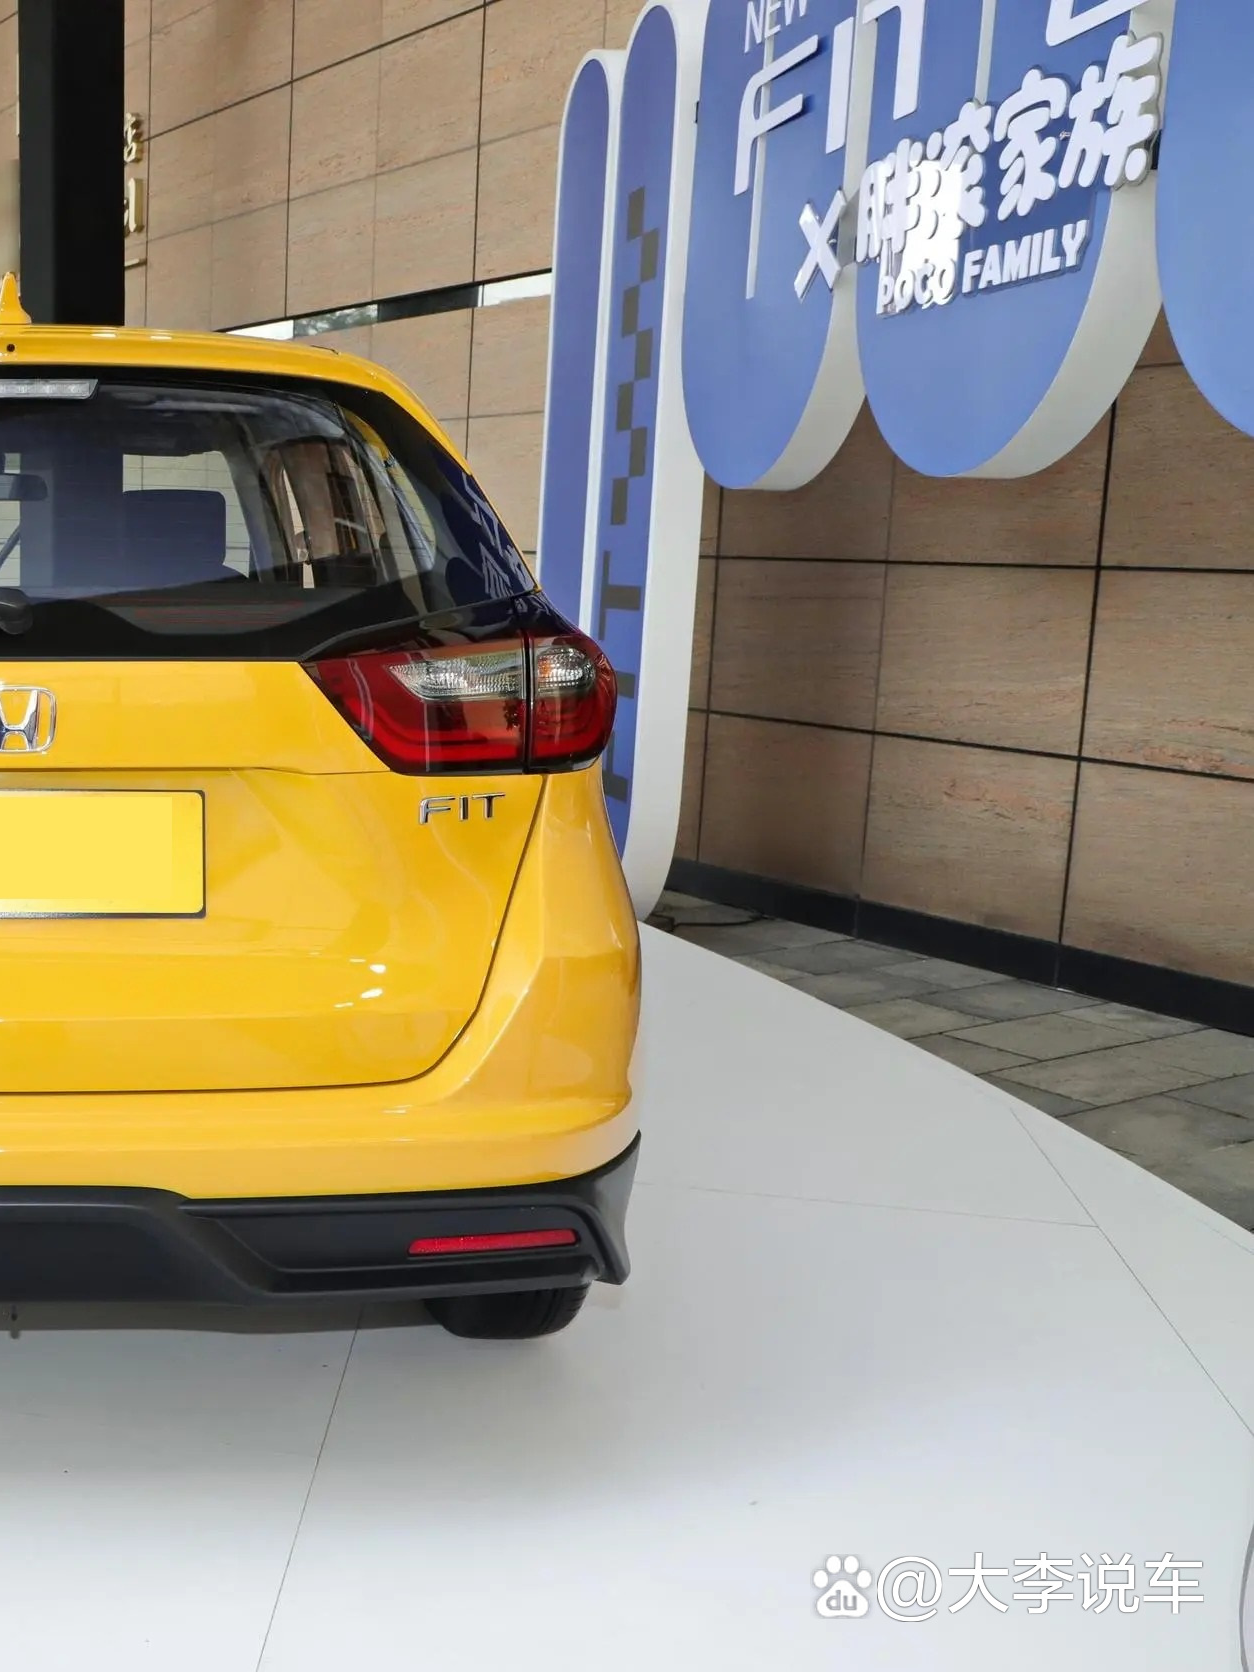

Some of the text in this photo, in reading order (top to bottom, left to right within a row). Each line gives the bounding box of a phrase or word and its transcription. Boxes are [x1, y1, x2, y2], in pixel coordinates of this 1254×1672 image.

[744, 0, 808, 52] NEW
[961, 219, 1090, 294] FAMILY
[418, 791, 507, 826] FIT
